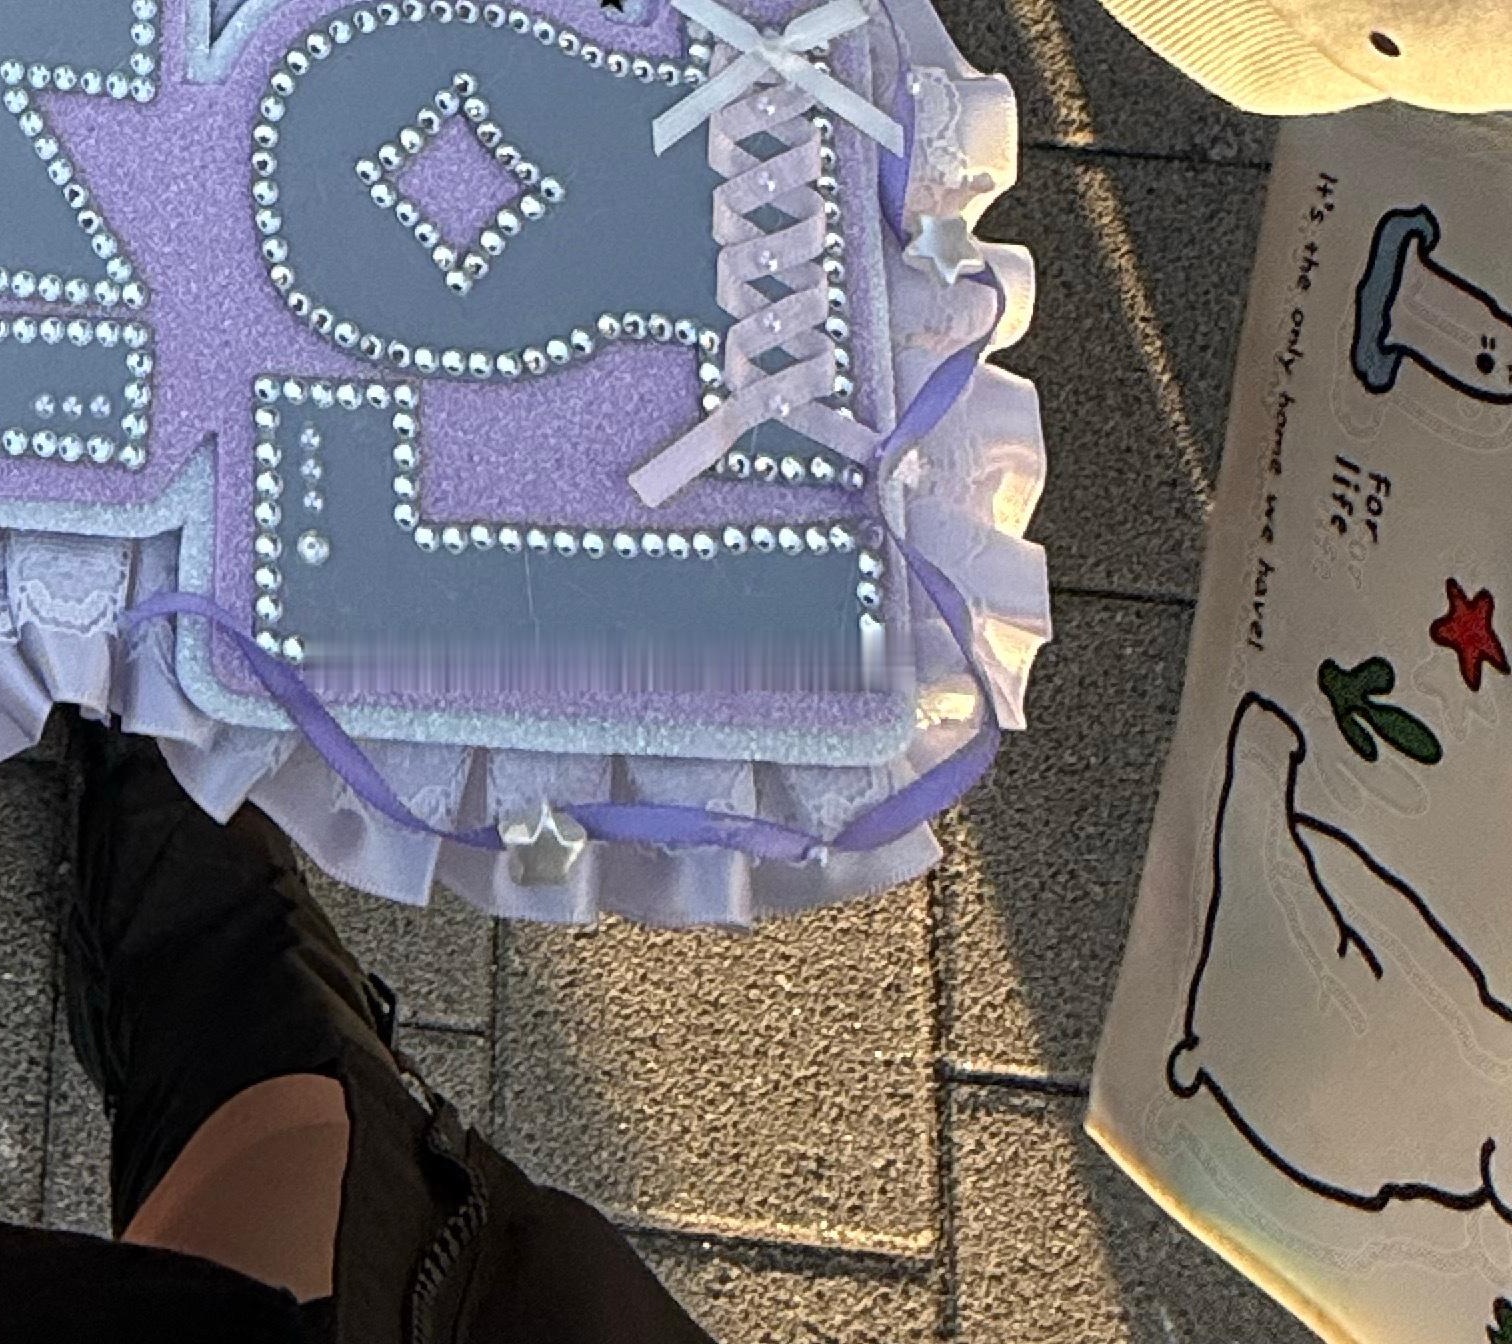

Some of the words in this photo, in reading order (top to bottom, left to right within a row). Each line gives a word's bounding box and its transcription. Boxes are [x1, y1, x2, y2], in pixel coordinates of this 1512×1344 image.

[1309, 172, 1338, 224] It's
[1296, 242, 1320, 291] the
[1275, 307, 1304, 376] only
[1270, 390, 1297, 476] home
[1260, 494, 1278, 544] we
[1329, 454, 1361, 536] life
